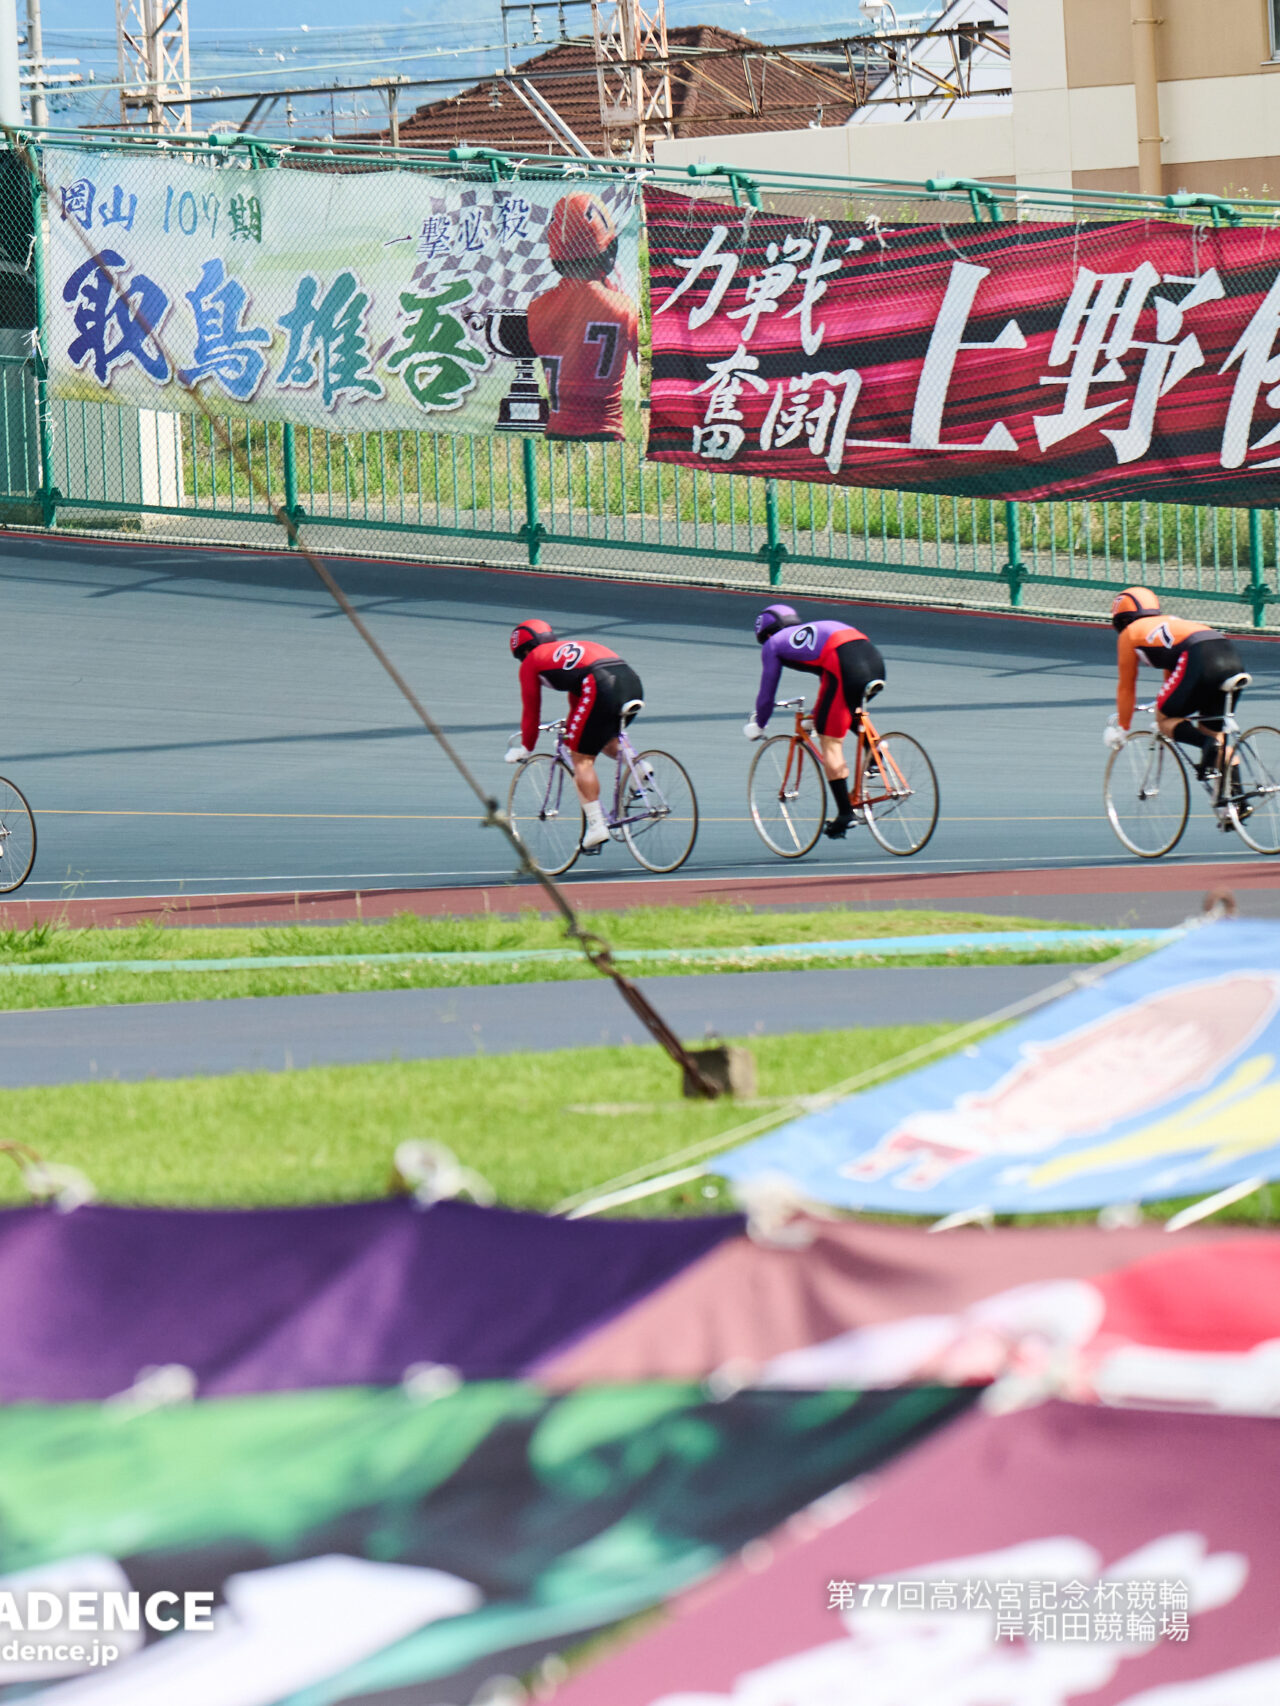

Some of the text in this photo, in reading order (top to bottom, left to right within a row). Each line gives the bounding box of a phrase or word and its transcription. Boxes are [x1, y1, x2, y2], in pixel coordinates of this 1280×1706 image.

[59, 178, 138, 232] 岡山
[384, 199, 529, 260] 一撃必殺
[584, 201, 608, 230] 7
[654, 224, 863, 356] 力戦
[63, 249, 491, 413] 取鳥雄吾
[584, 322, 621, 380] 7
[687, 344, 862, 474] 奮闘
[553, 642, 585, 671] 3
[789, 624, 818, 651] 9
[1145, 621, 1175, 649] 7
